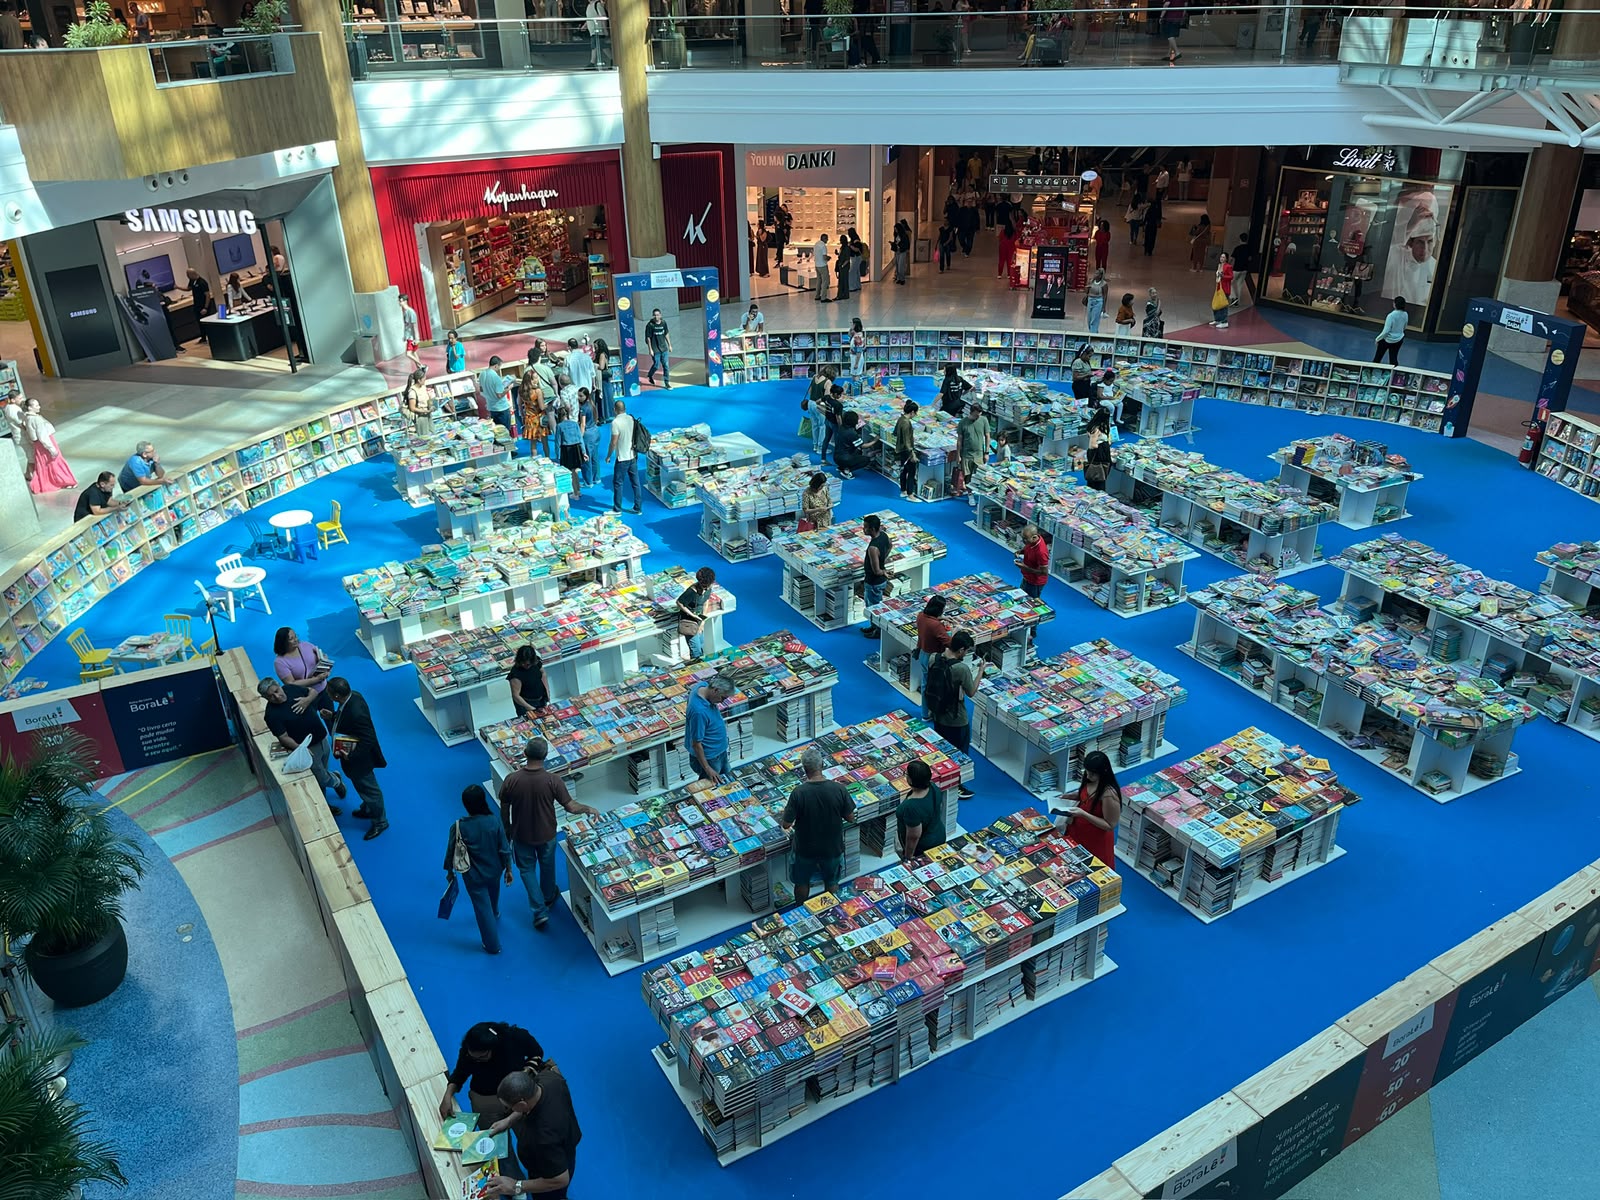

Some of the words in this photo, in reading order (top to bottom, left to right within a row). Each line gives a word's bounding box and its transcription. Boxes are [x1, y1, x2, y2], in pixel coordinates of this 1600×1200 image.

[750, 152, 767, 166] YOU
[786, 149, 836, 171] DANKI
[1332, 148, 1382, 169] Lindt
[484, 181, 559, 212] Kopenhagen
[125, 208, 257, 235] SAMSUNG
[70, 308, 98, 318] SAMSUNG
